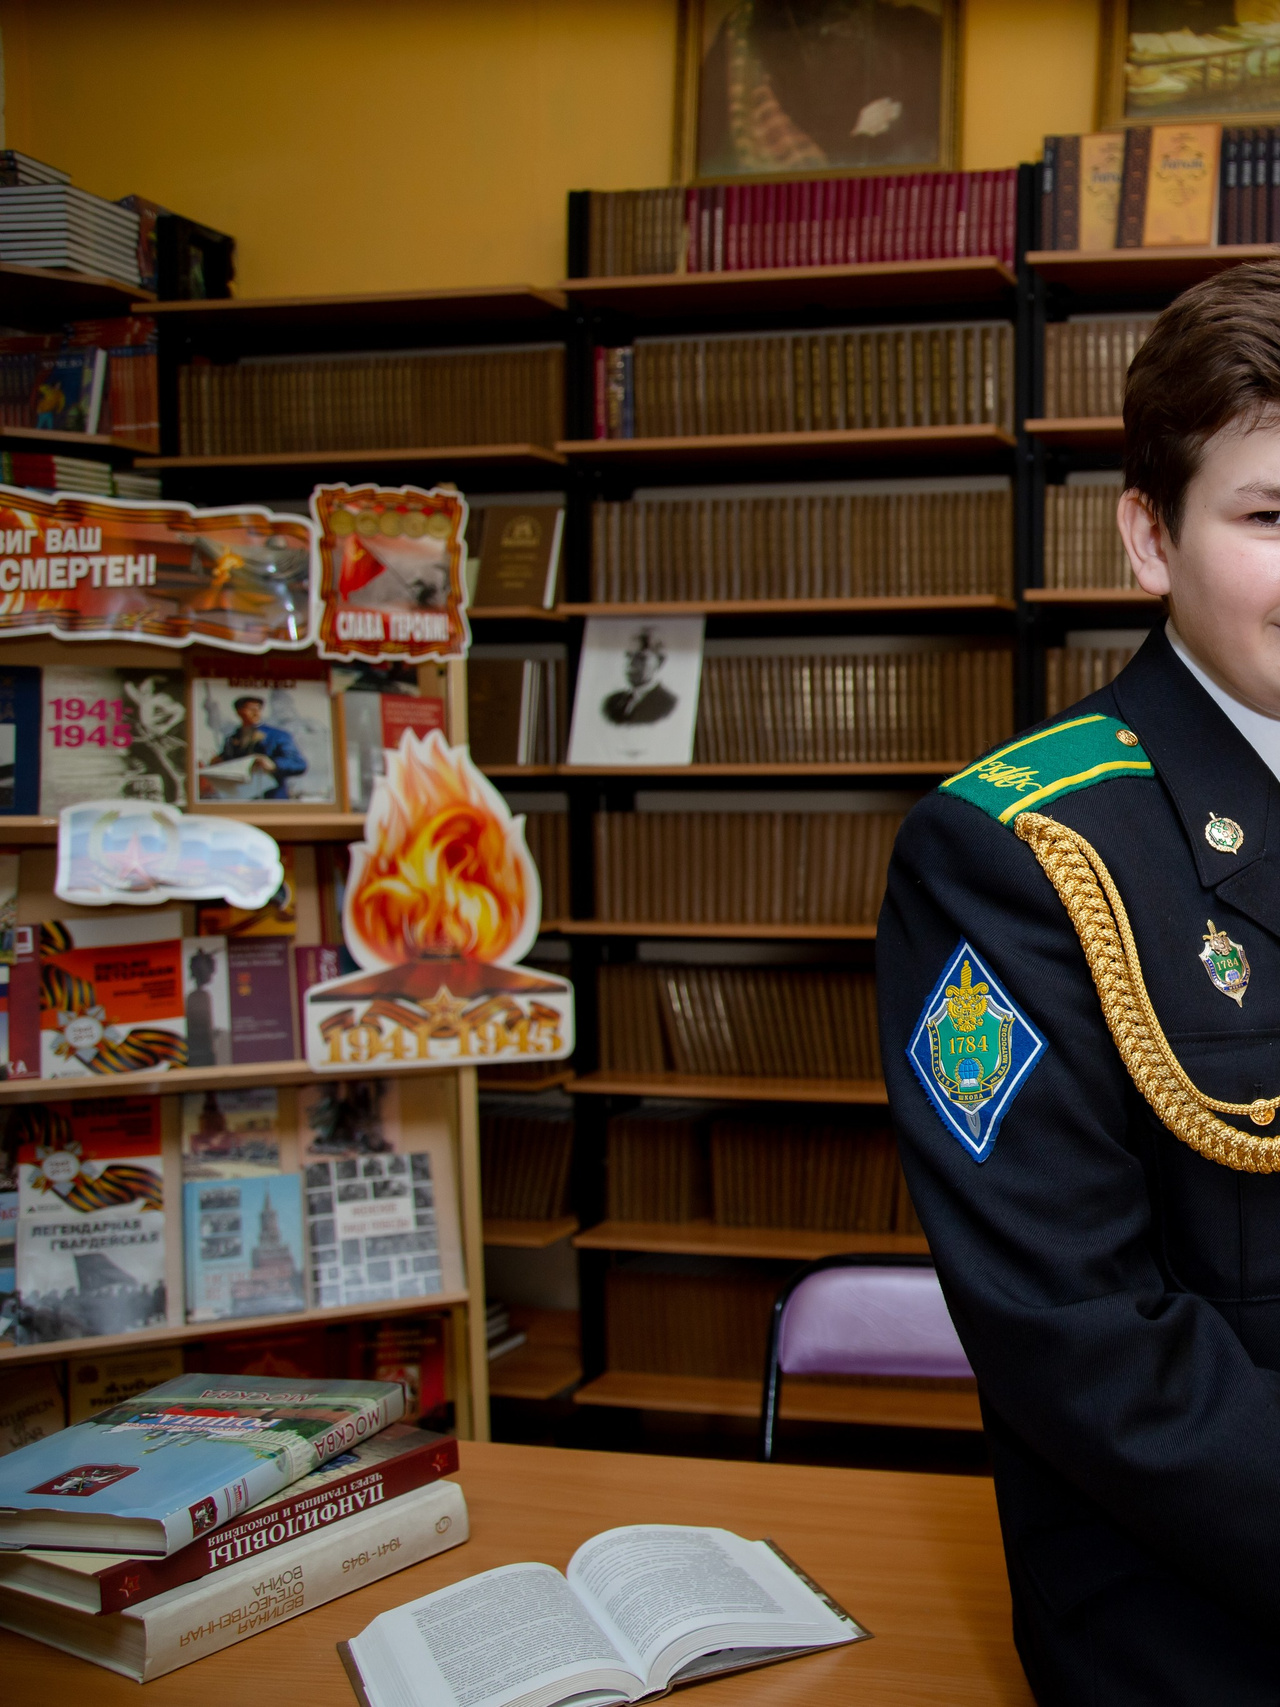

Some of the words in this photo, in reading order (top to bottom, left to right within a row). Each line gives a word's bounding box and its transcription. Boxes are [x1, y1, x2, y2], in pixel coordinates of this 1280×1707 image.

[46, 526, 102, 553] ВАШ
[0, 553, 157, 592] СМЕРТЕН!
[336, 611, 386, 641] СЛАВА
[48, 697, 134, 722] 1941-
[48, 723, 133, 748] 1945
[1216, 957, 1240, 971] 1784
[949, 1035, 989, 1056] 1784
[1001, 1023, 1009, 1064] МАТРОСОВА
[930, 1028, 951, 1087] КАДЕТСКАЯ
[958, 1093, 984, 1101] ШКОЛА
[32, 1219, 142, 1238] ЛЕГЕНДАРНАЯ
[51, 1231, 160, 1251] ГВАРДЕЙСКАЯ
[201, 1389, 318, 1402] МОСКВА
[313, 1406, 382, 1461] МОСКВА
[349, 1472, 383, 1491] ЧЕРЕЗ
[282, 1507, 291, 1517] И
[294, 1487, 348, 1512] ГРАНИЦЫ
[207, 1482, 386, 1569] ПАНФИЛОВЦЫ
[207, 1510, 279, 1548] ПОКОЛЕНИЯ
[341, 1536, 403, 1574] 1941-1945
[252, 1565, 304, 1597] ВОЙНА
[179, 1580, 304, 1648] ОТЕЧЕСТВЕННАЯ
[237, 1594, 305, 1636] ВЕЛИКАЯ
